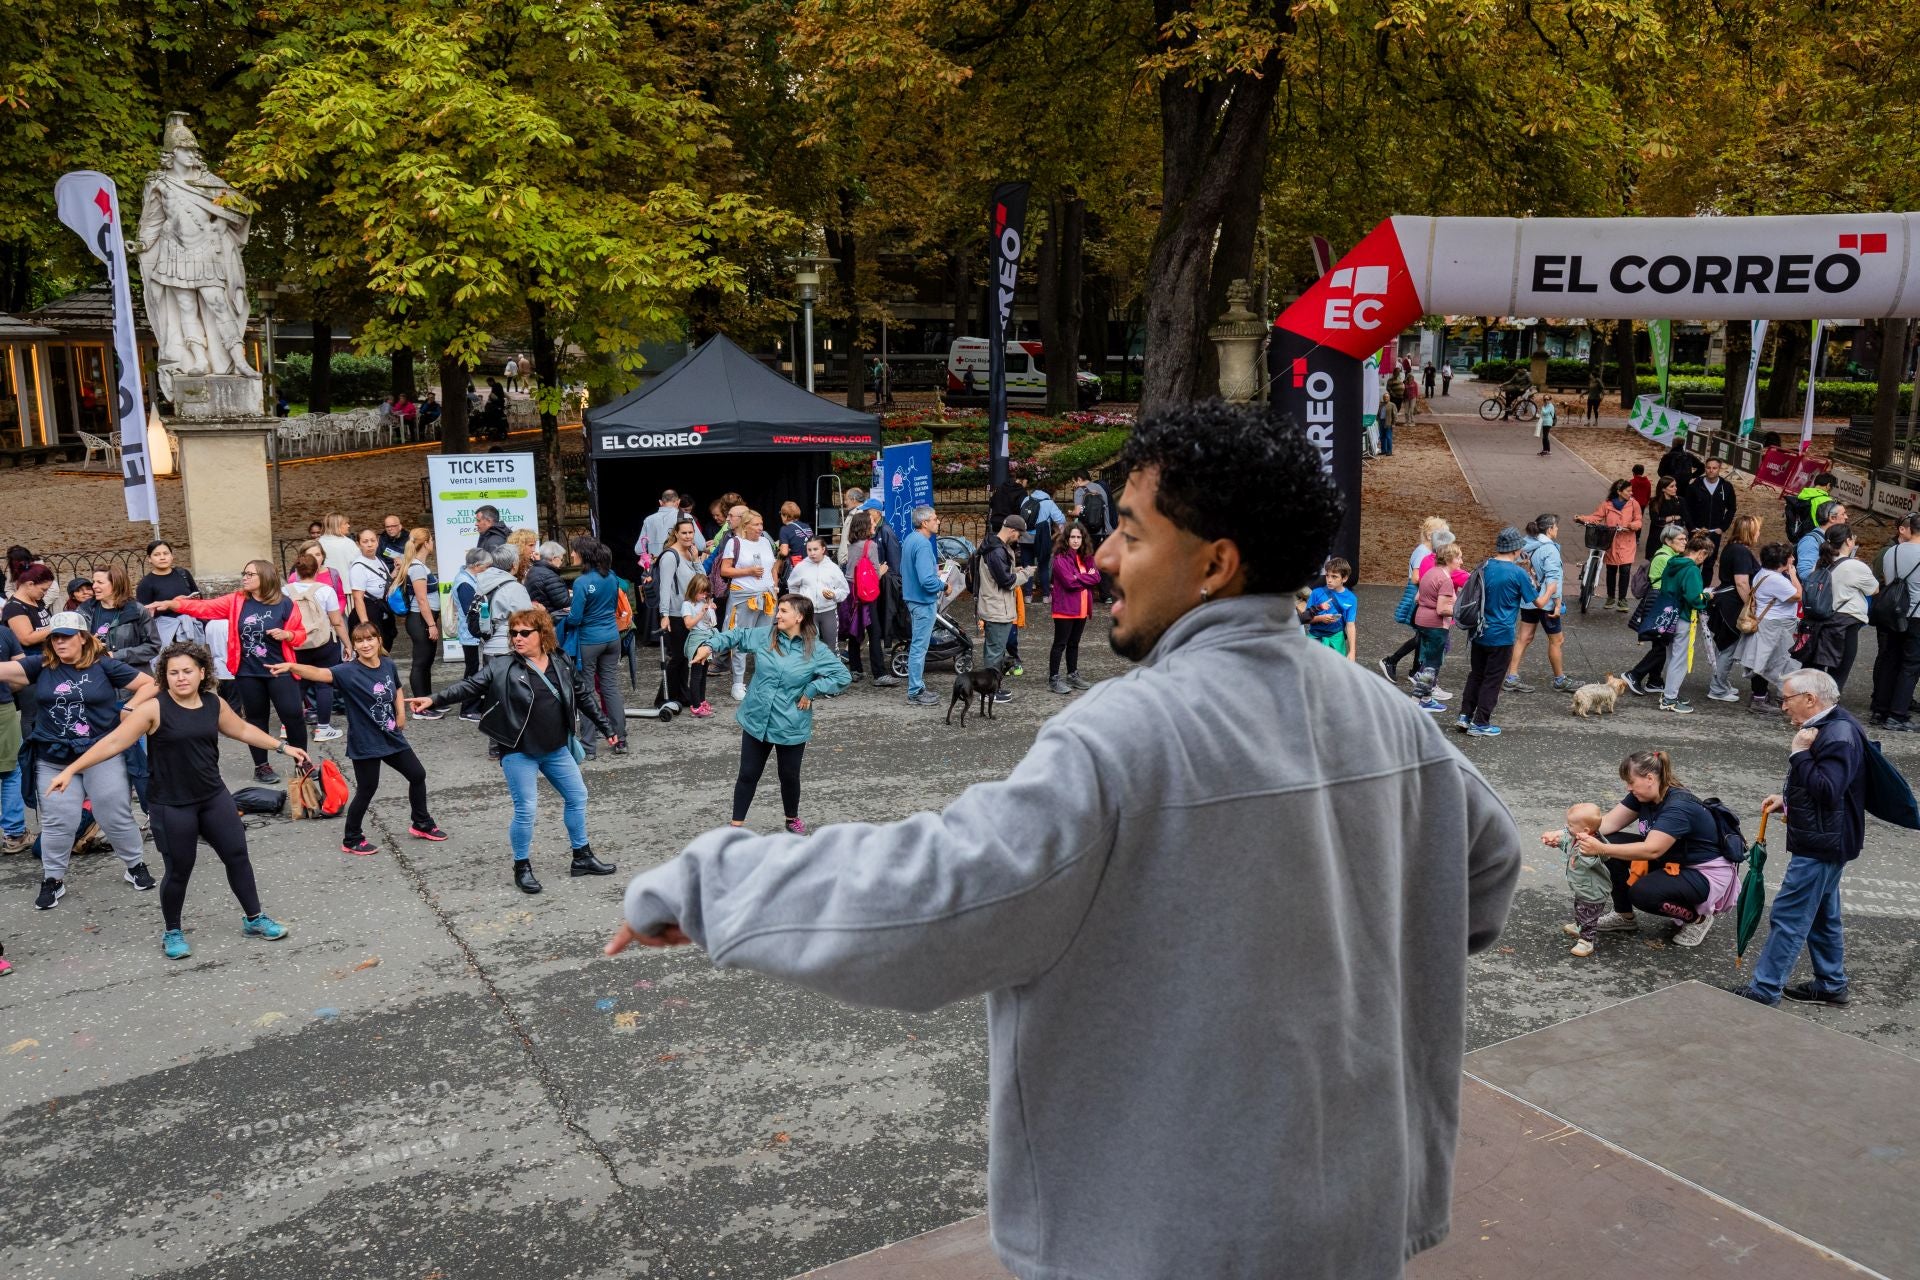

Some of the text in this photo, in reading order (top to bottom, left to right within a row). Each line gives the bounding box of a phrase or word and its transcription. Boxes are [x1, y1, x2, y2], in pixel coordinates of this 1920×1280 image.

[1532, 253, 1861, 294] EL CORREO
[1324, 298, 1384, 330] EC
[602, 432, 702, 450] EL CORREO
[772, 434, 872, 444] www.elcorreo.com
[448, 459, 515, 474] TICKETS
[450, 476, 515, 485] Venta Salmenta
[1840, 479, 1864, 497] CORREO
[479, 491, 489, 499] 4€
[1878, 490, 1886, 502] EL
[1885, 493, 1913, 511] CORREO
[457, 507, 511, 517] XII MHA
